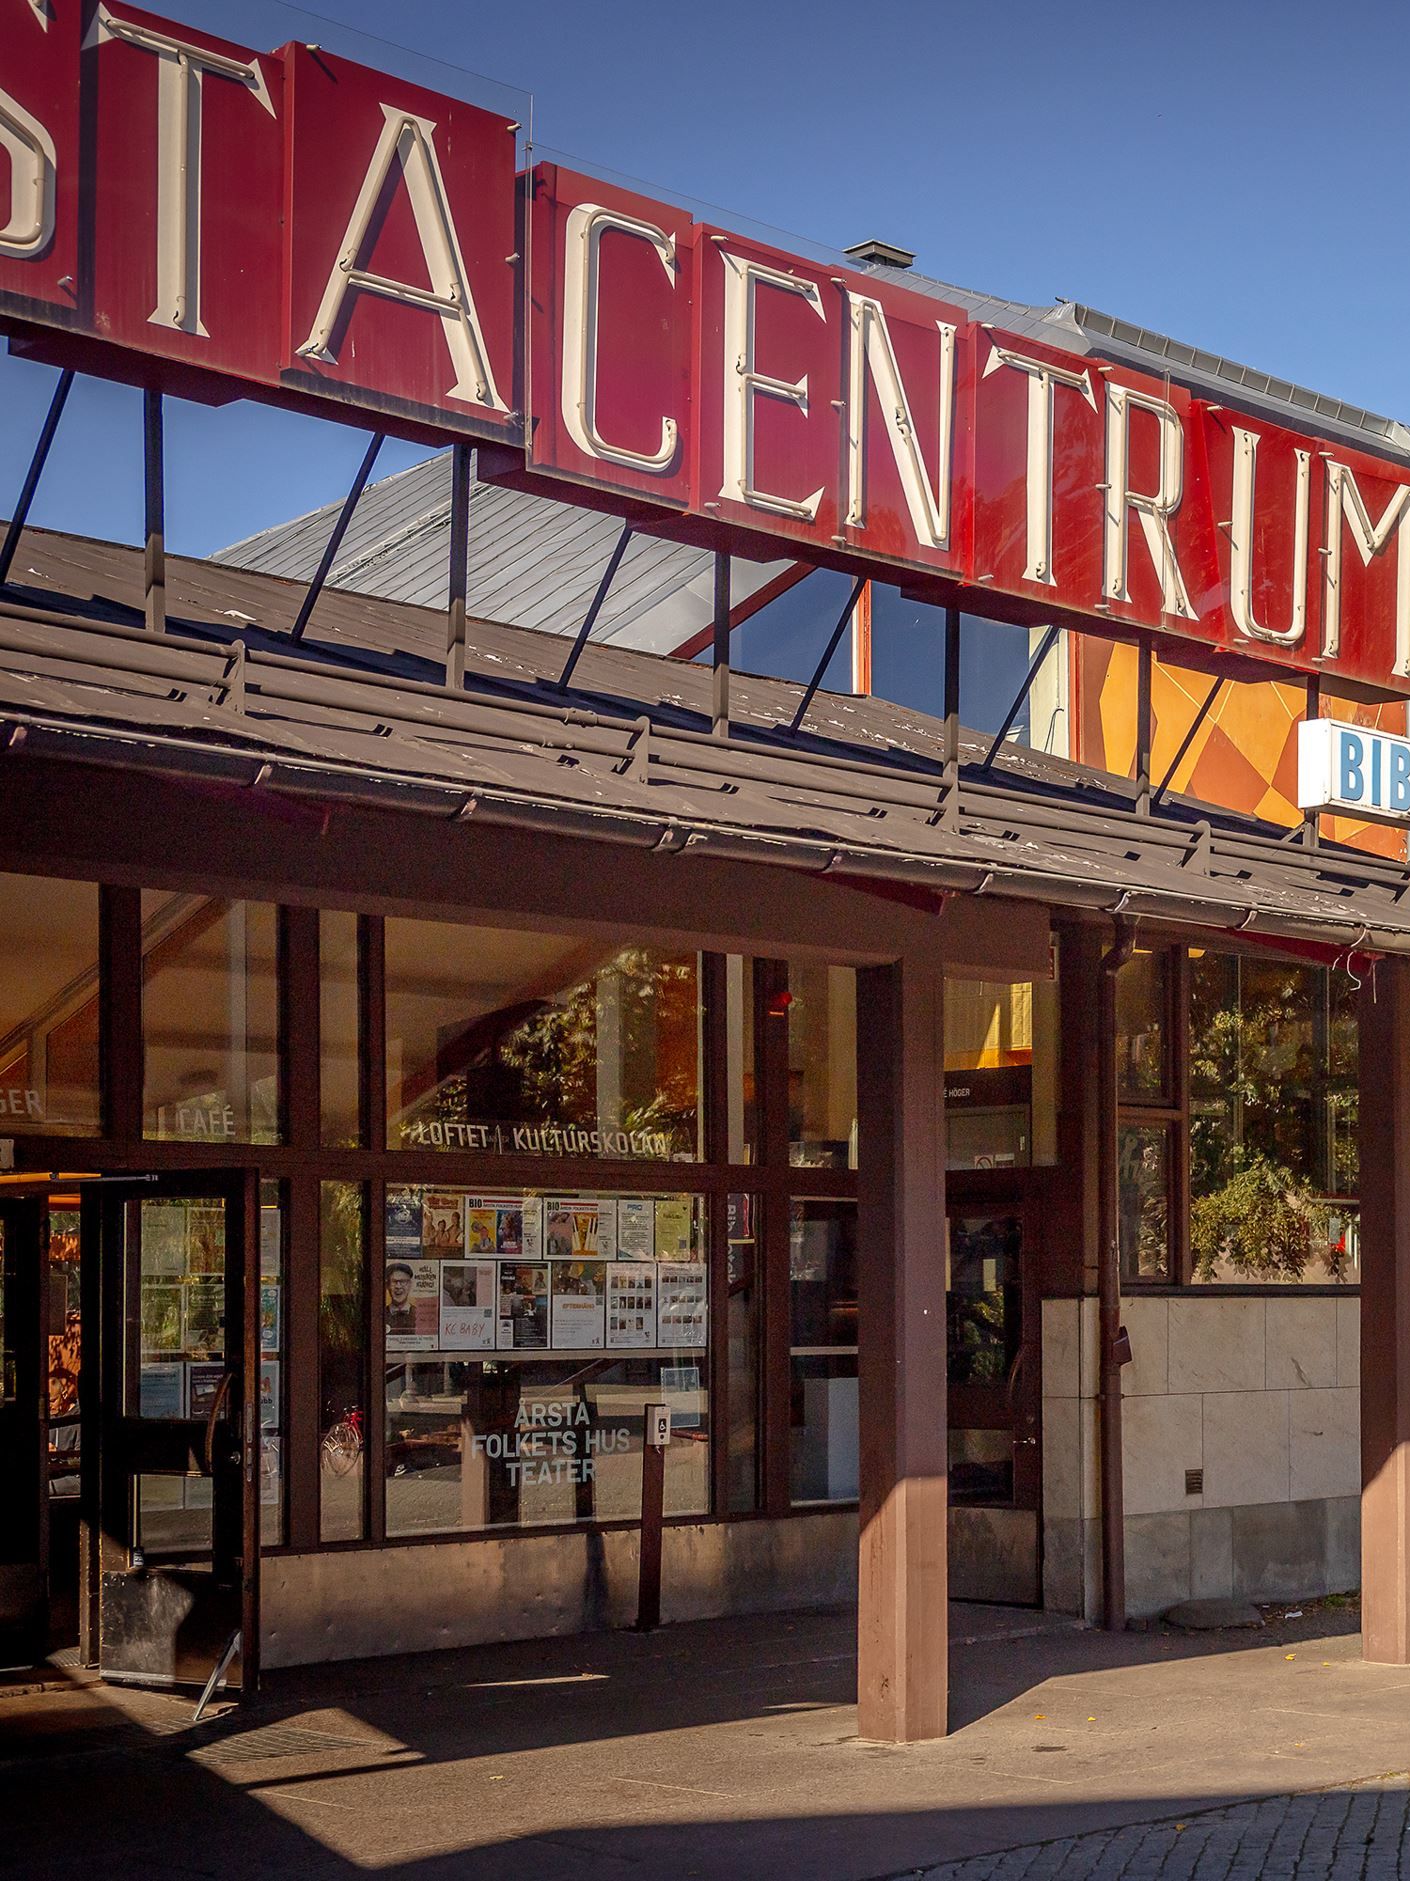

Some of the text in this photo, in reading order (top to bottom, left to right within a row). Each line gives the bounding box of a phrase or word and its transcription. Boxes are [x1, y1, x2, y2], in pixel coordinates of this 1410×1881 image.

[949, 1087, 971, 1098] HÖGER
[180, 1104, 236, 1136] CAFÉ
[418, 1121, 667, 1155] LOFTET KULTURSKOLAN
[468, 1198, 482, 1208] BIO
[547, 1201, 560, 1211] BIO
[514, 1397, 590, 1429] ÅRSTA
[471, 1427, 631, 1460] FOLKETS HUS
[506, 1458, 596, 1488] TEATER
